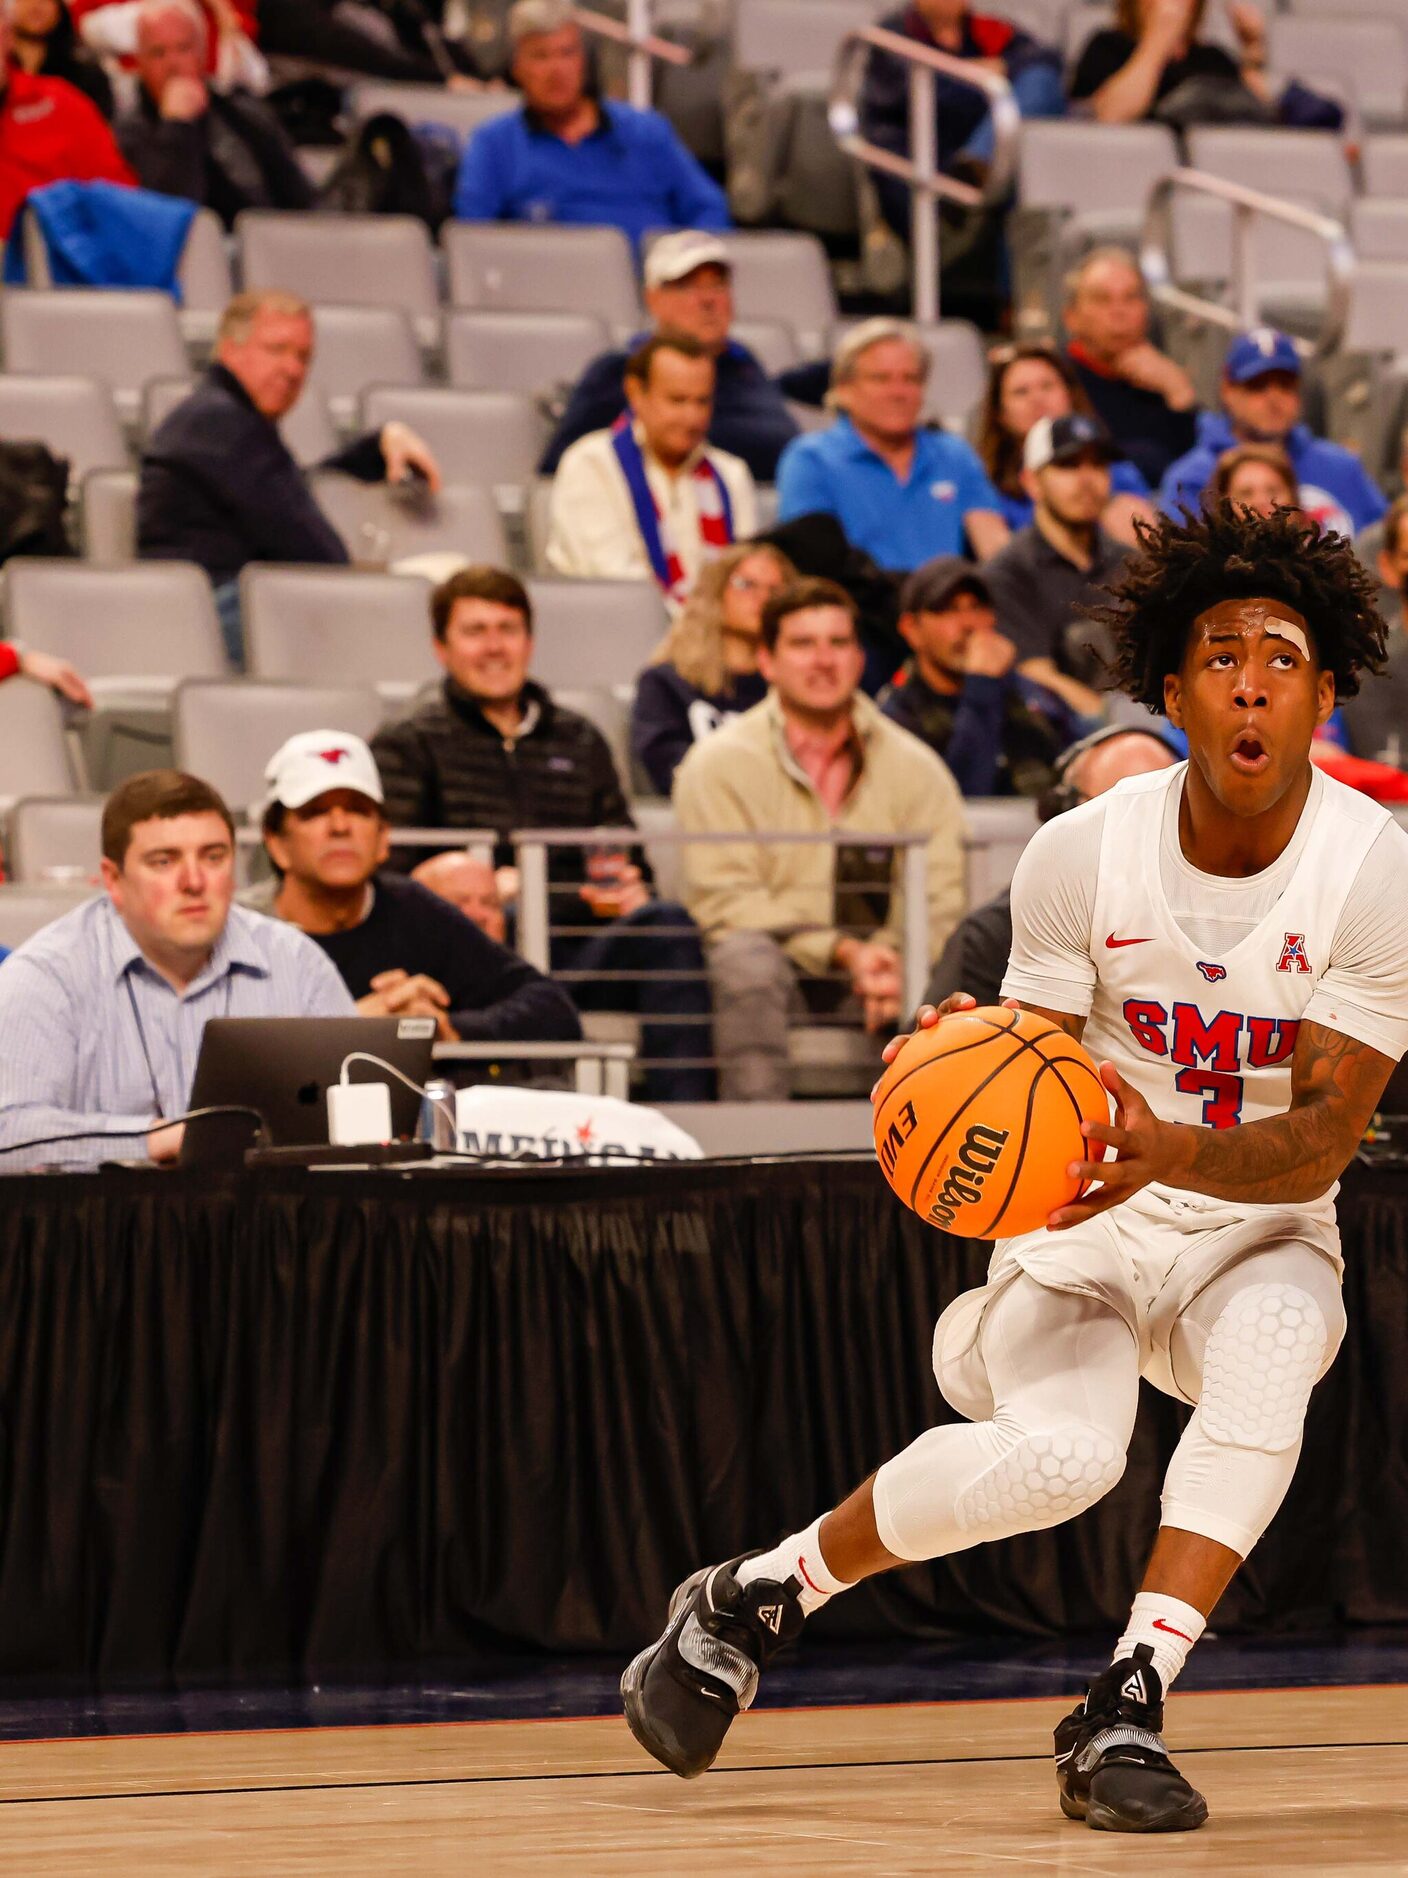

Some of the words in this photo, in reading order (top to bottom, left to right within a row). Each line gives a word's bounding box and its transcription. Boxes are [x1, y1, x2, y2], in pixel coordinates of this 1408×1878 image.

[1276, 932, 1312, 974] A
[1123, 998, 1300, 1072] SMU
[1175, 1067, 1244, 1129] 3
[926, 1123, 1010, 1229] Wilson
